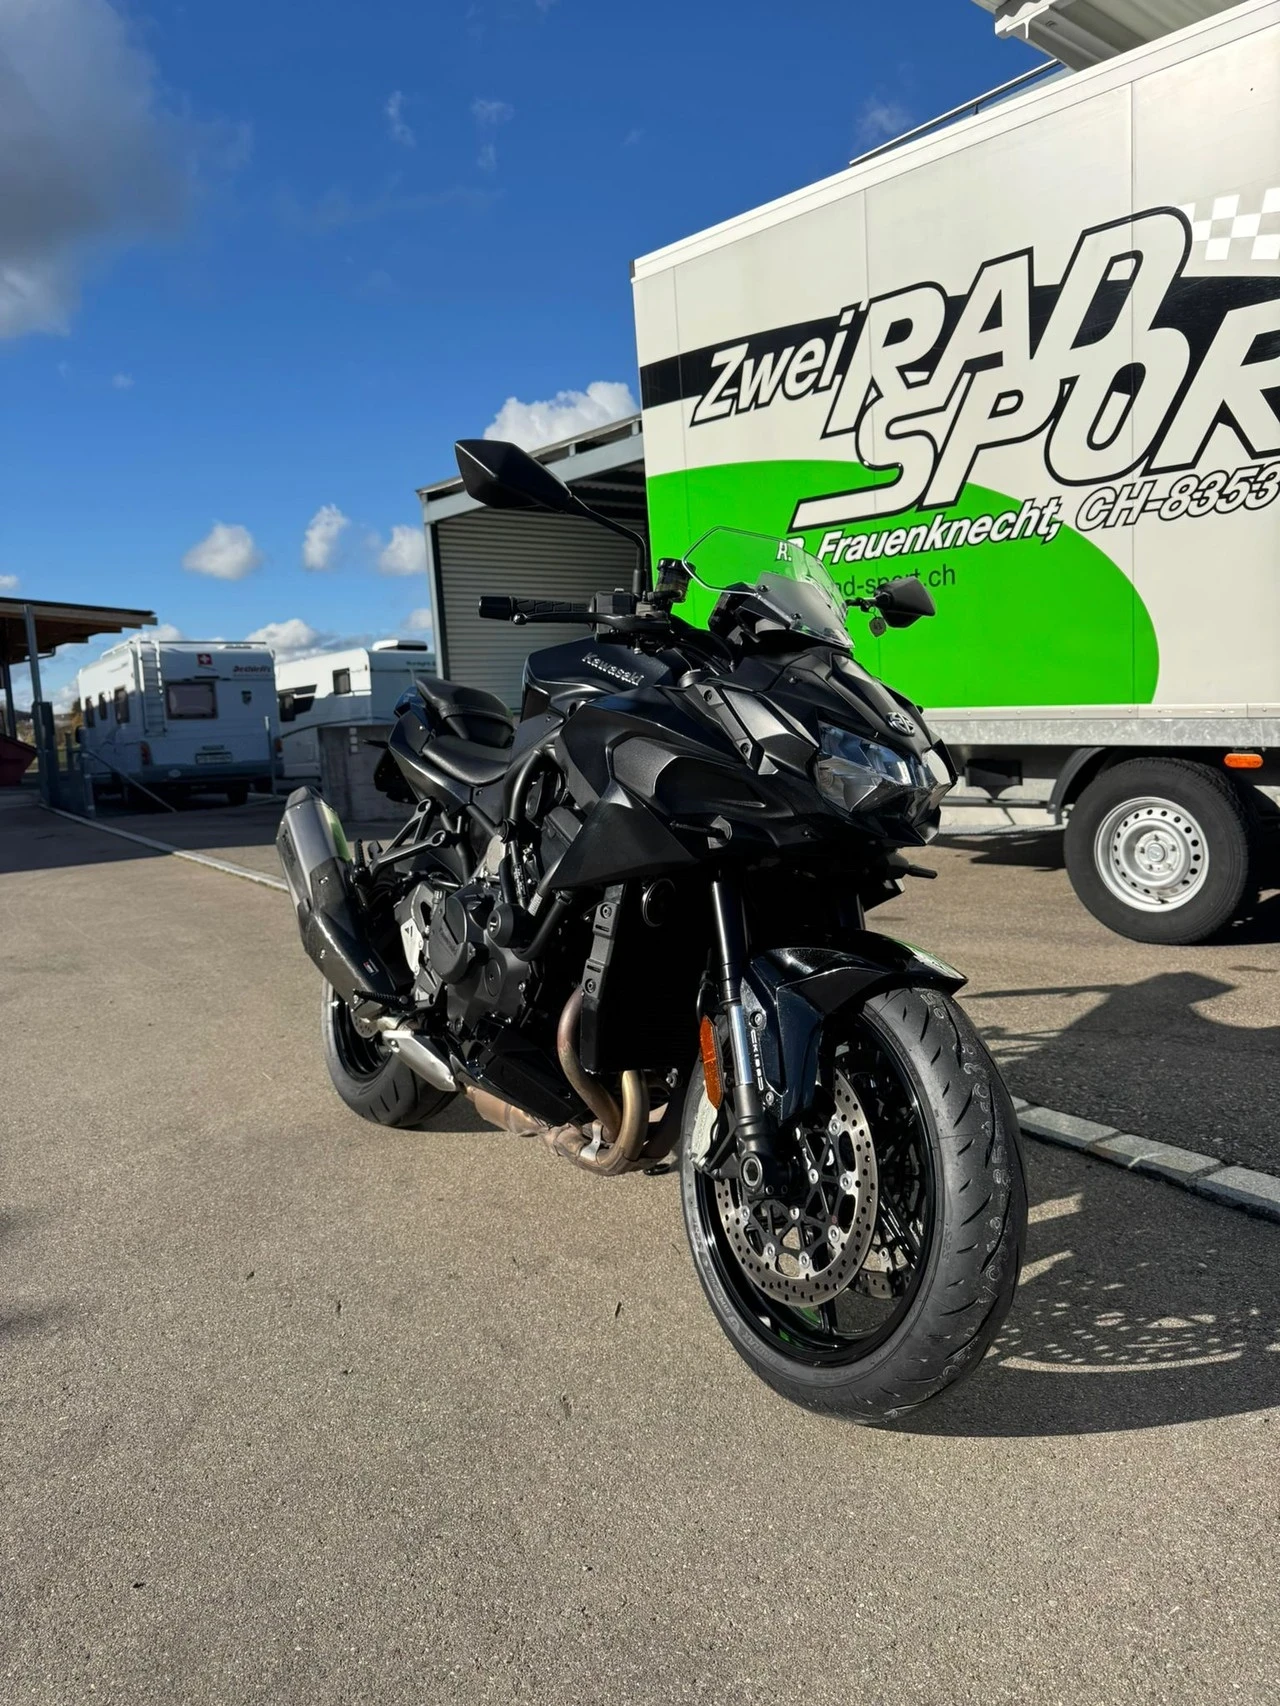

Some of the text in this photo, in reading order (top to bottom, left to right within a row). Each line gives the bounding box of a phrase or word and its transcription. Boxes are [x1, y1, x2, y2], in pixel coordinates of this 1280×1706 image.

[690, 206, 1193, 440] Zwei RAD
[815, 496, 1065, 567] Frauenknecht,
[1074, 461, 1280, 532] CH-8353
[582, 652, 645, 686] Kawasaki
